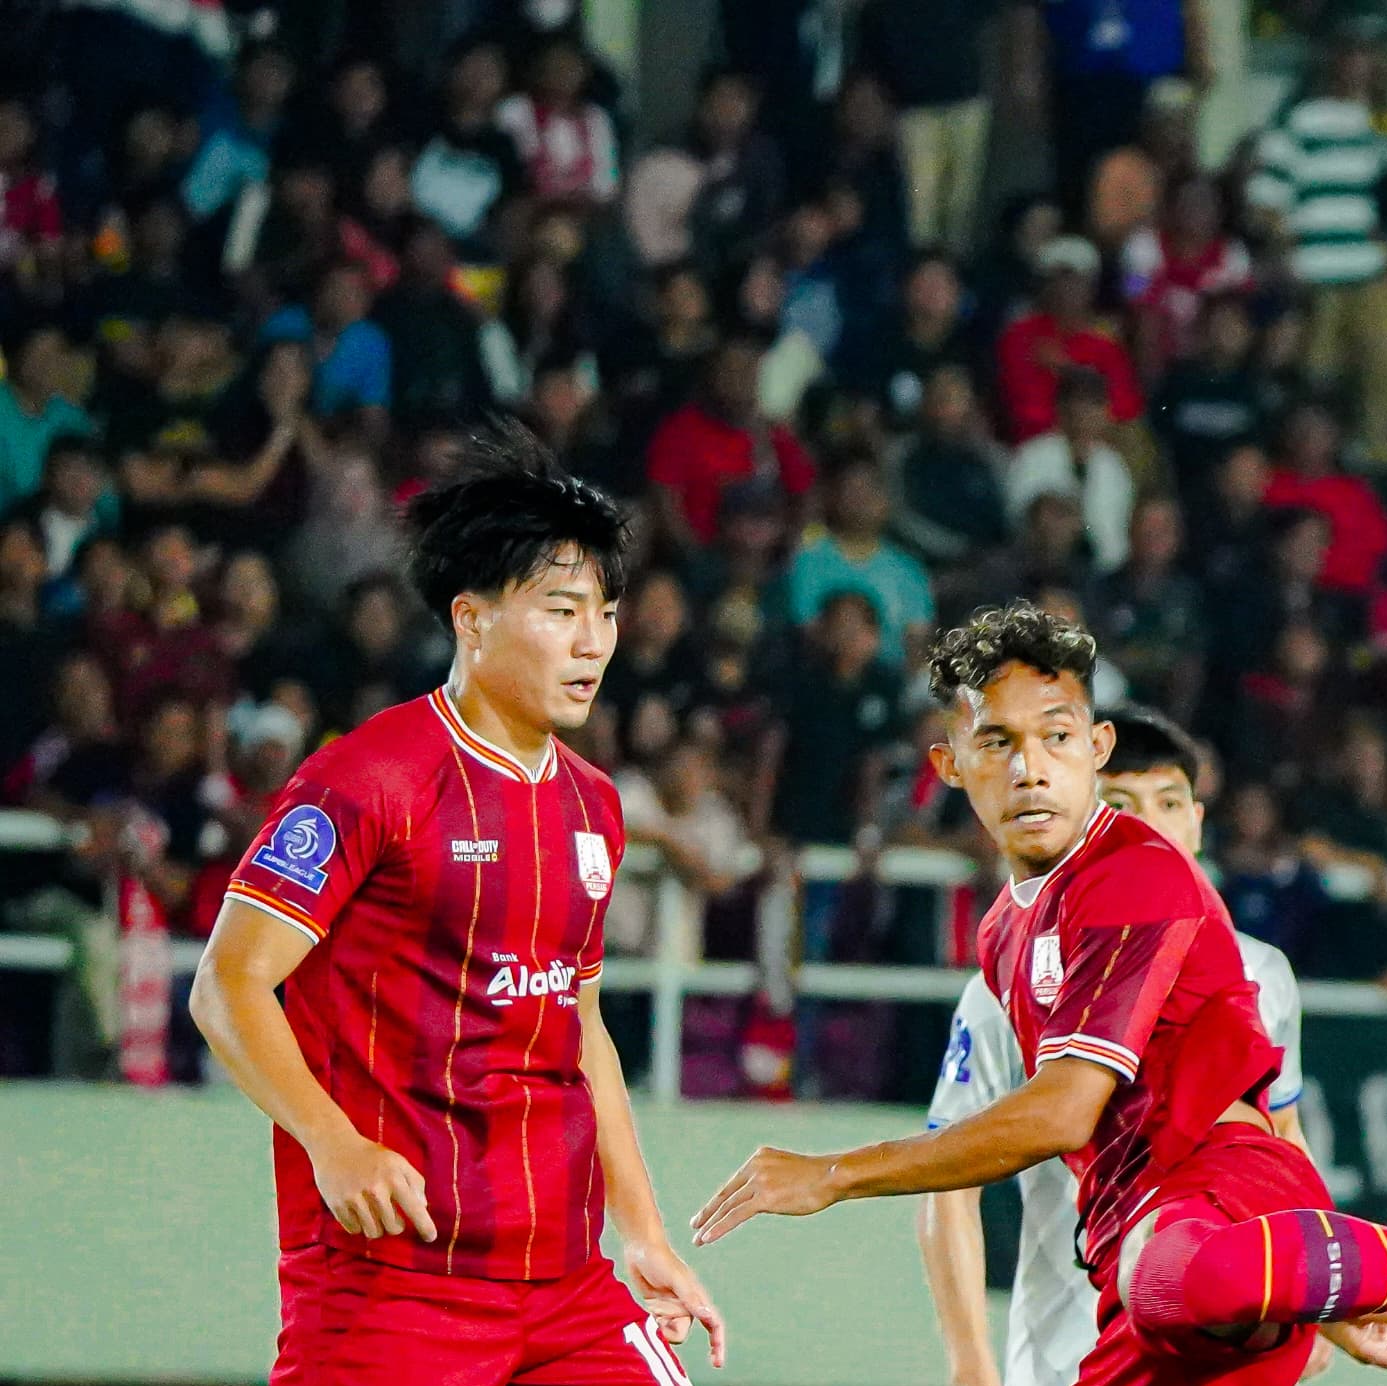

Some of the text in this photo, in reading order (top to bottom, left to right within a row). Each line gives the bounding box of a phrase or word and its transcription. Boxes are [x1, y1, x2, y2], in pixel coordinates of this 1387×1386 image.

[451, 840, 474, 853] CALL
[478, 840, 499, 853] DUTY
[453, 854, 491, 862] MOBILE
[491, 952, 519, 962] Bank
